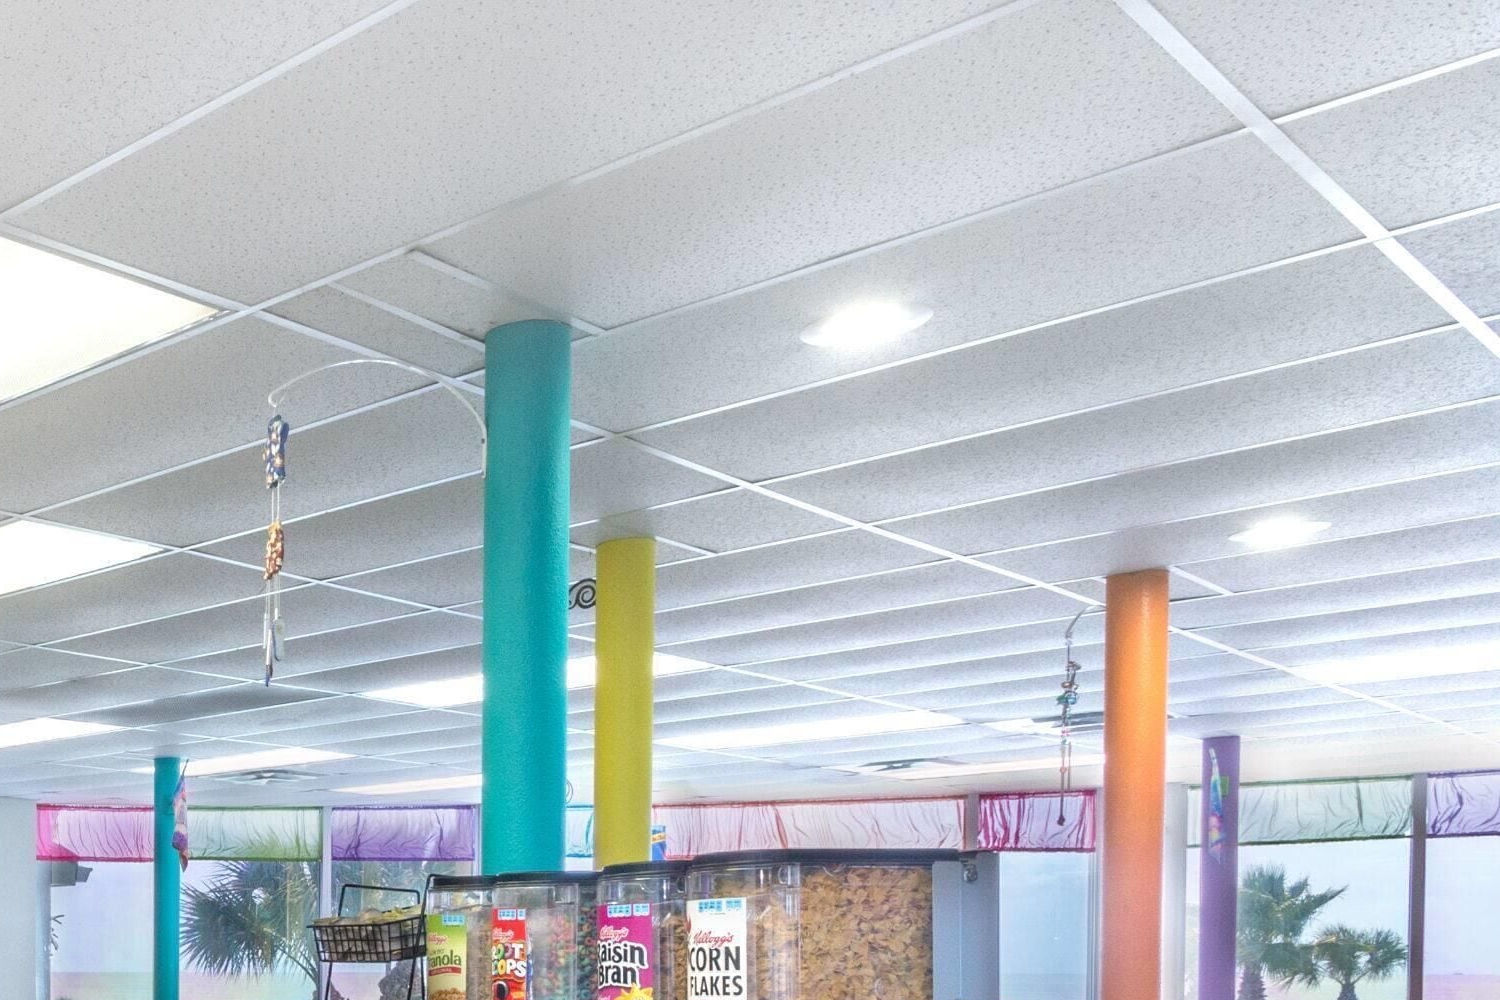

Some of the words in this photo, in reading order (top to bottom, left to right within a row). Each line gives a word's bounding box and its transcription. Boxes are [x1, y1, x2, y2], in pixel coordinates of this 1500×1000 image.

[694, 930, 734, 948] Kellogg's
[429, 949, 462, 968] anola
[598, 941, 647, 967] aisin
[689, 946, 741, 972] CORN
[691, 975, 743, 997] FLAKES
